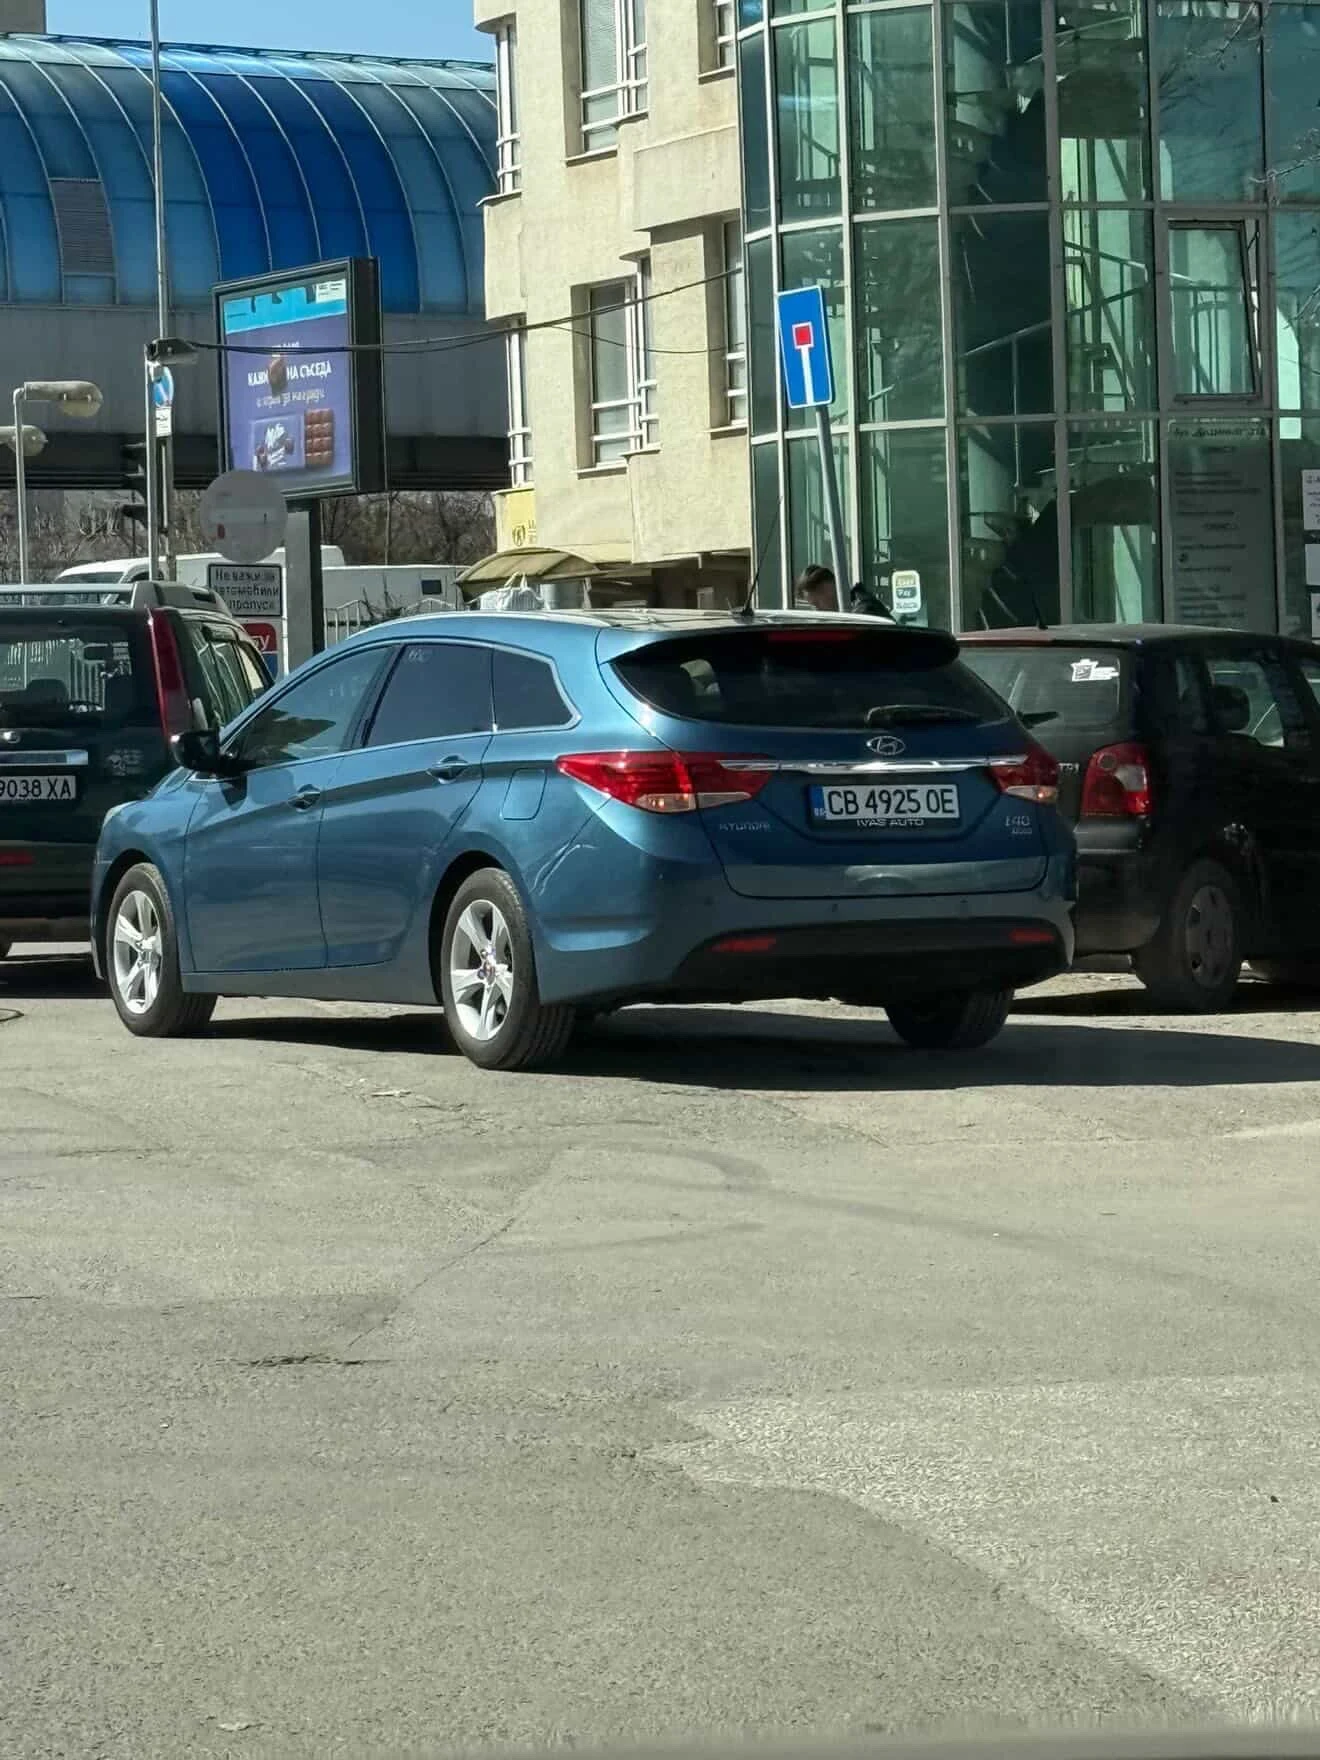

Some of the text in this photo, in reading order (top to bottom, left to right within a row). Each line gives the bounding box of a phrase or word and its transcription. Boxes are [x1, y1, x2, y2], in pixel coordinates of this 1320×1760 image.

[286, 366, 299, 380] НА
[300, 360, 333, 378] СЪСЕДА
[47, 778, 71, 798] XA
[827, 790, 859, 815] CB
[864, 790, 921, 814] 4925
[857, 817, 924, 827] IVAS AUTO
